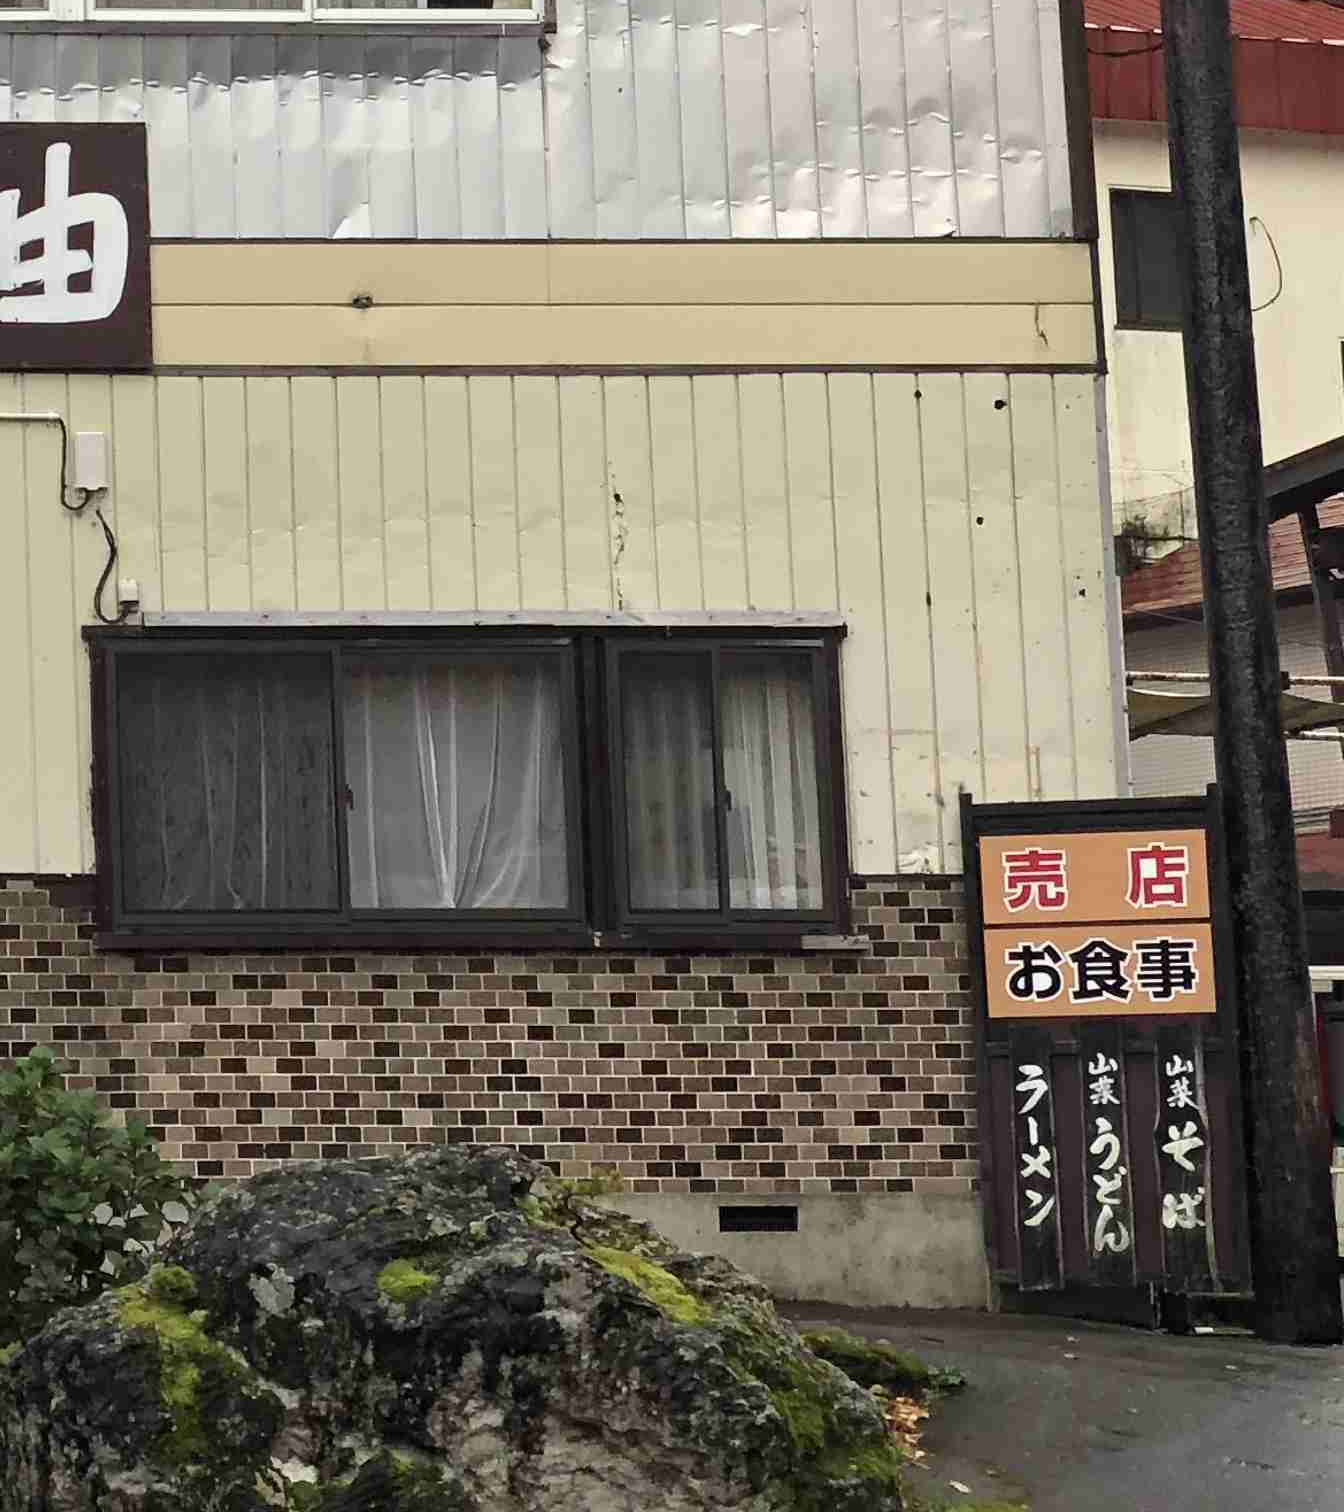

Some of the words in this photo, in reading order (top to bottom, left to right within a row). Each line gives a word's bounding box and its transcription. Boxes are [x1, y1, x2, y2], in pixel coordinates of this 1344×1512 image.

[1003, 844, 1189, 911] 売店
[1005, 937, 1197, 1002] お食事
[1015, 1064, 1056, 1227] ラーメン
[1087, 1052, 1130, 1254] 山菜うどん
[1161, 1054, 1208, 1229] 山菜そば
